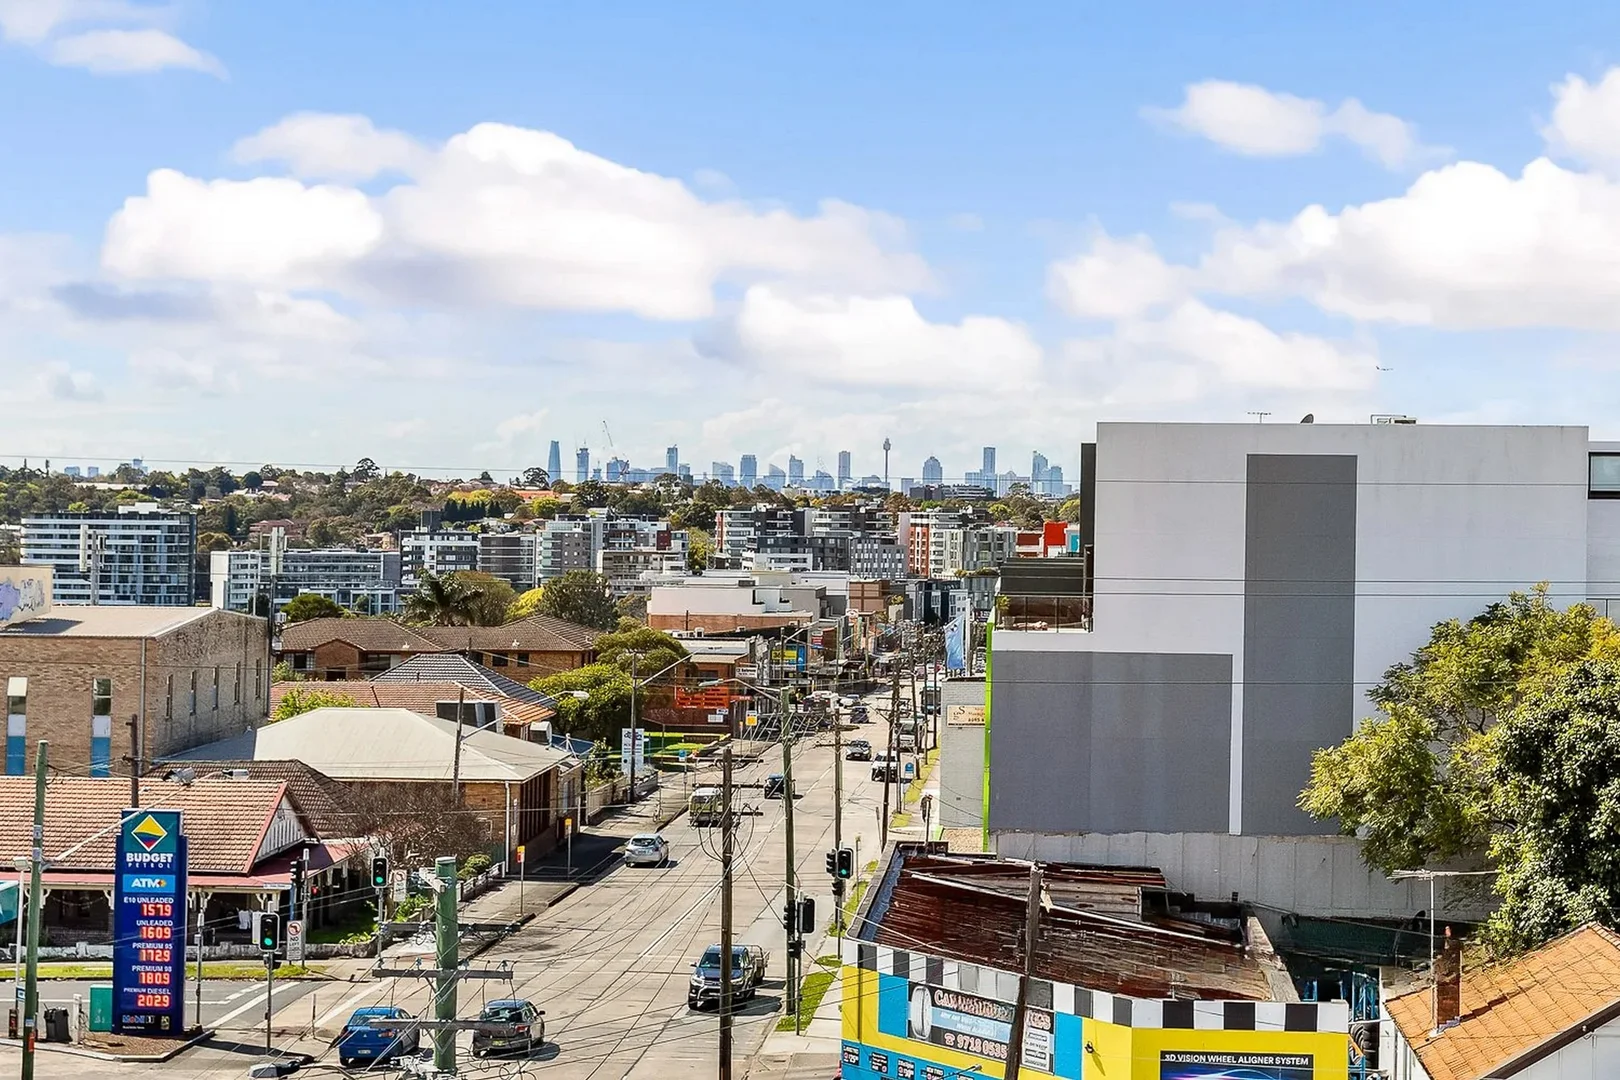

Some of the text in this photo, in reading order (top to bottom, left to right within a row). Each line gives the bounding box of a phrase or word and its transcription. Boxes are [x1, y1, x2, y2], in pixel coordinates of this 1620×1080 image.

[126, 852, 174, 863] BUDGET
[131, 878, 161, 888] ATM
[123, 896, 174, 904] E10 UNLEADED
[1165, 1054, 1309, 1066] 3D VISION WHEEL ALIGNER SYSTEM
